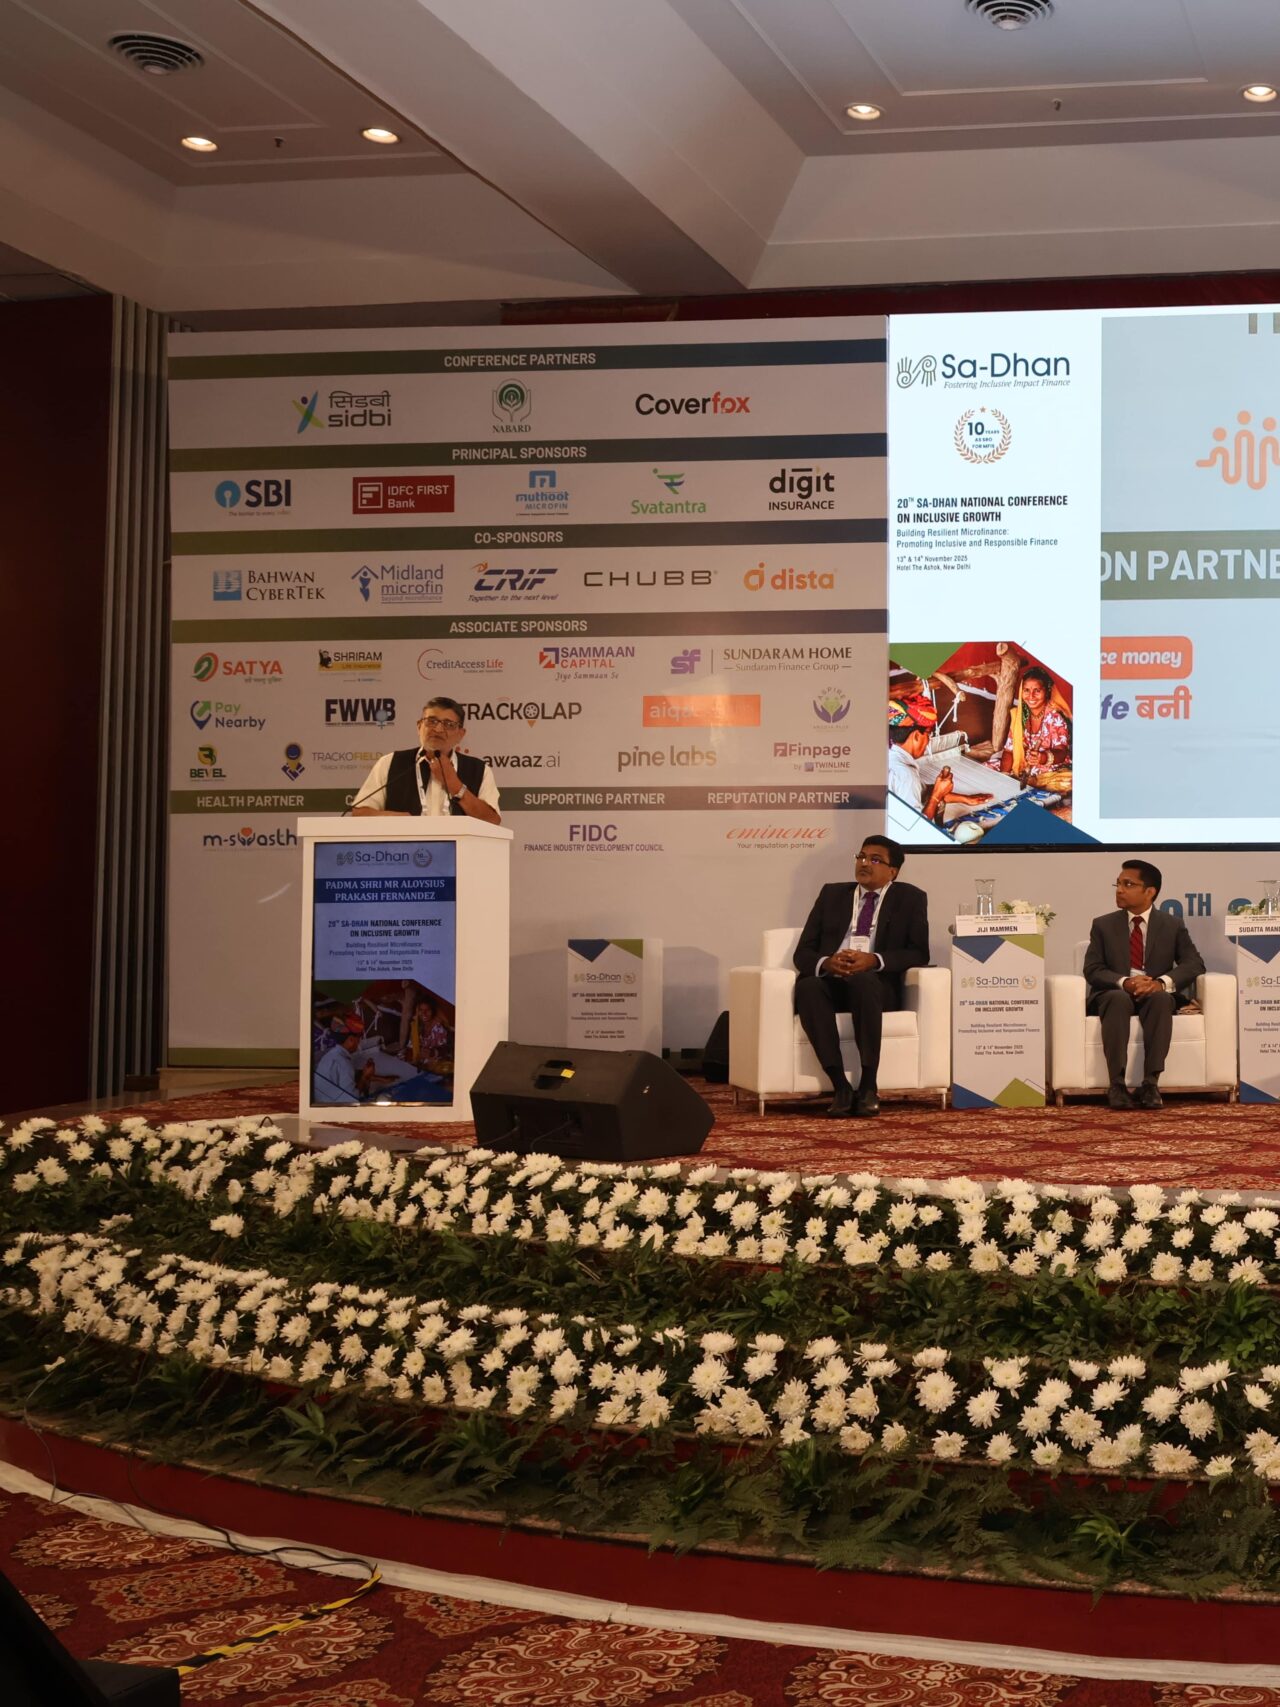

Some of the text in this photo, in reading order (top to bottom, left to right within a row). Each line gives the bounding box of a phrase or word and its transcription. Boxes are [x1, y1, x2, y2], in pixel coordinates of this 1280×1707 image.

[444, 353, 596, 367] CONFERENCE PARTNERS
[942, 353, 1069, 378] Sa-Dhan
[1014, 380, 1039, 388] Impact
[329, 390, 391, 408] सिडबी
[636, 392, 750, 415] Coverfox
[328, 409, 391, 427] sidbi
[968, 422, 985, 435] 10
[453, 447, 586, 459] PRINCIPAL SPONSORS
[769, 468, 834, 499] digit
[245, 480, 291, 507] SBI
[388, 485, 449, 495] IDFC FIRST
[388, 499, 415, 508] Bank
[631, 500, 707, 514] Svatantra
[769, 501, 834, 510] INSURANCE
[917, 498, 957, 508] SA-DHAN
[961, 497, 1005, 507] NATIONAL
[1008, 496, 1067, 506] CONFERENCE
[898, 512, 1001, 523] ON INCLUSIVE GROWTH
[475, 531, 563, 543] CO-SPONSORS
[897, 529, 925, 538] Building
[897, 540, 933, 549] Promoting
[969, 539, 982, 547] and
[381, 564, 443, 582] Midland
[584, 571, 711, 586] CHUBB
[771, 568, 834, 590] dista
[381, 580, 443, 595] microfin
[450, 620, 587, 632] ASSOCIATE SPONSORS
[332, 652, 382, 664] SHRIRAM
[561, 647, 634, 658] SAMMAAN
[724, 647, 851, 659] SUNDARAM HOME
[223, 660, 283, 675] SATYA
[559, 659, 614, 668] CAPITAL
[736, 662, 839, 672] Sundaram Finance Group
[214, 702, 241, 716] Pay
[326, 698, 395, 722] FWWB
[215, 717, 265, 730] Nearby
[789, 744, 851, 758] Finpage
[483, 751, 560, 768] awaaz.ai
[618, 745, 716, 772] pine labs
[197, 795, 304, 807] HEALTH PARTNER
[525, 793, 665, 804] SUPPORTING PARTNER
[708, 792, 850, 805] REPUTATION PARTNER
[570, 825, 617, 841] FIDC
[524, 843, 664, 852] FINANCE INDUSTRY DEVELOPMENT COUNCIL
[754, 842, 790, 850] reputation
[791, 842, 816, 850] partner
[355, 851, 409, 862] Sa-Dhan
[326, 881, 358, 889] PADMA
[385, 880, 399, 888] MR
[401, 880, 445, 888] ALOYSIUS
[381, 892, 437, 900] FERNANDEZ
[976, 977, 1018, 985] Sa-Dhan
